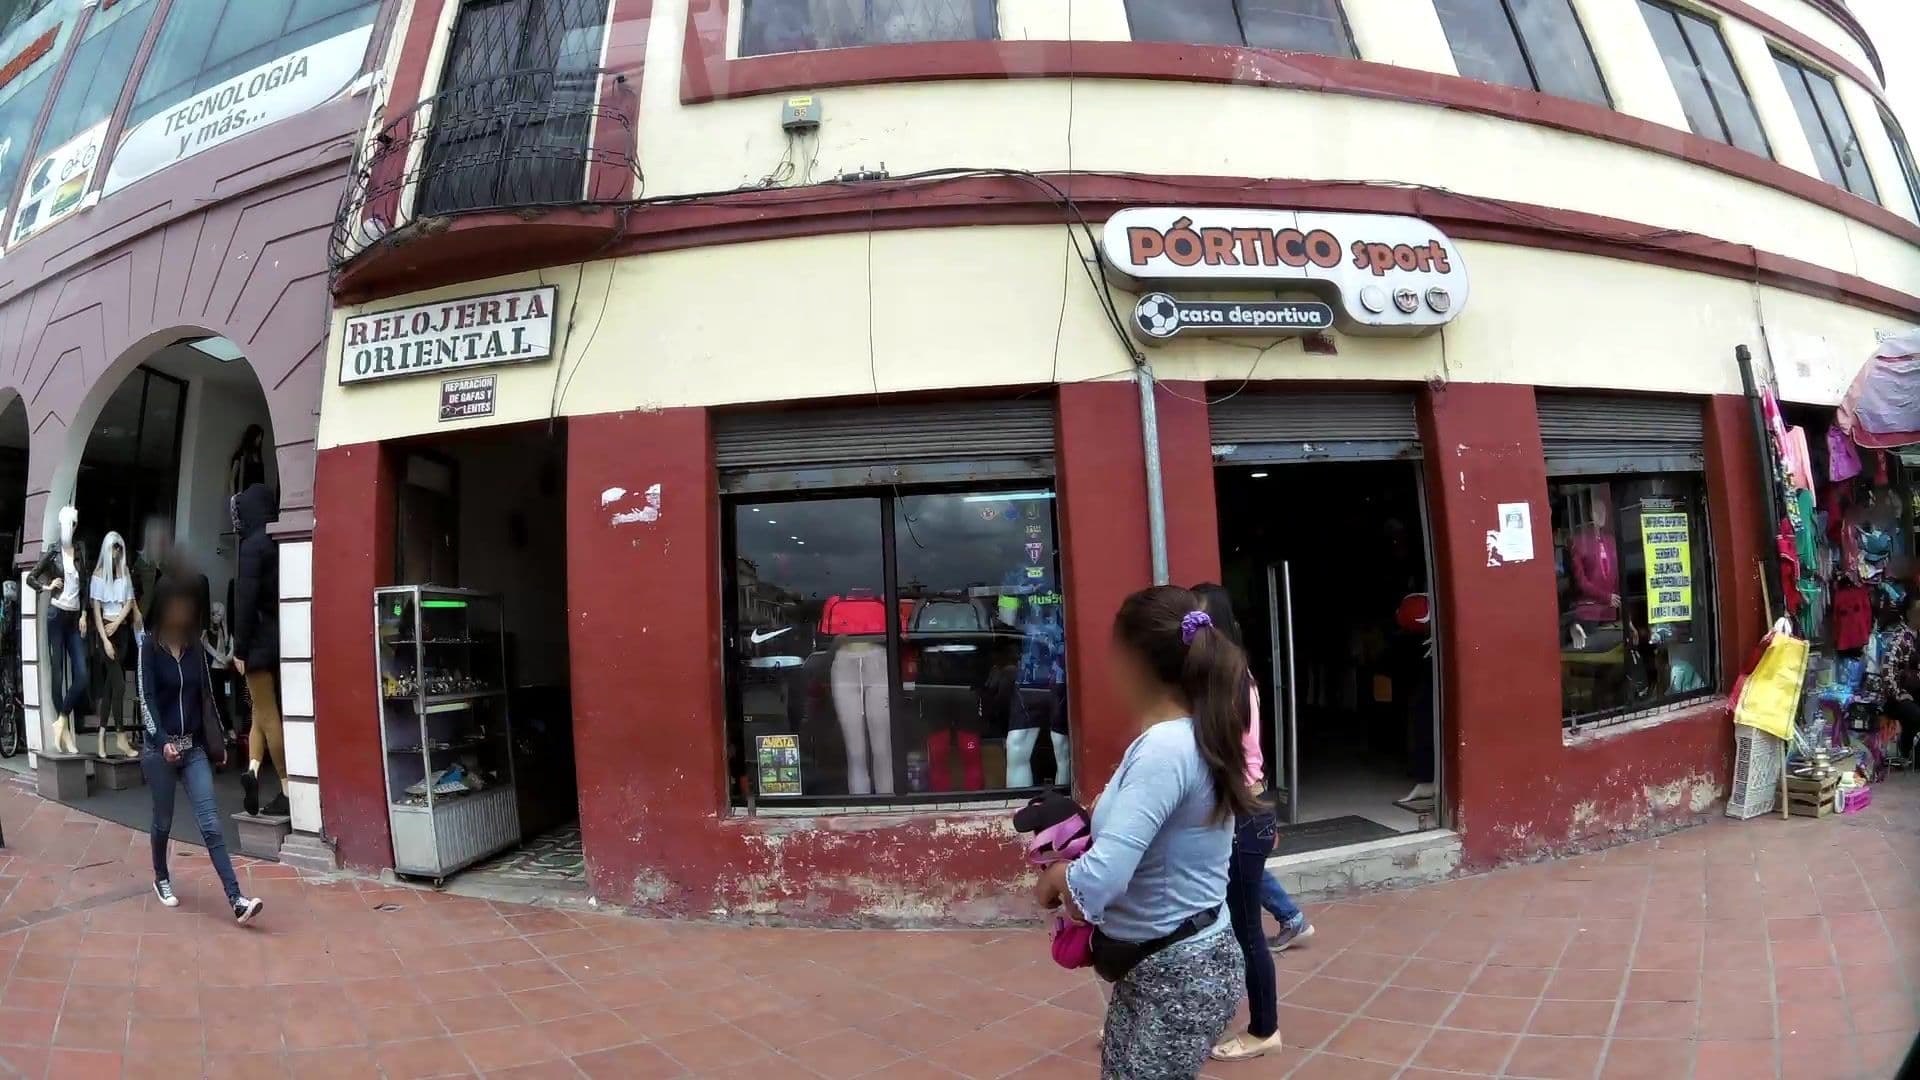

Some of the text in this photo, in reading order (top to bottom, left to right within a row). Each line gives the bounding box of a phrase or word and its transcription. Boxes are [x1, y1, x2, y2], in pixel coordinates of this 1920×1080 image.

[165, 56, 308, 136] TECNOLOGÍA
[176, 132, 192, 159] y
[1127, 216, 1451, 276] PÓRTICO sport
[348, 294, 548, 347] RELOJERIA
[1180, 305, 1321, 326] casa deportiva
[354, 326, 532, 376] ORIENTAL
[445, 378, 493, 392] REPARACION
[449, 393, 460, 404] DE
[460, 390, 486, 402] GAFAS
[463, 402, 491, 414] LENTES
